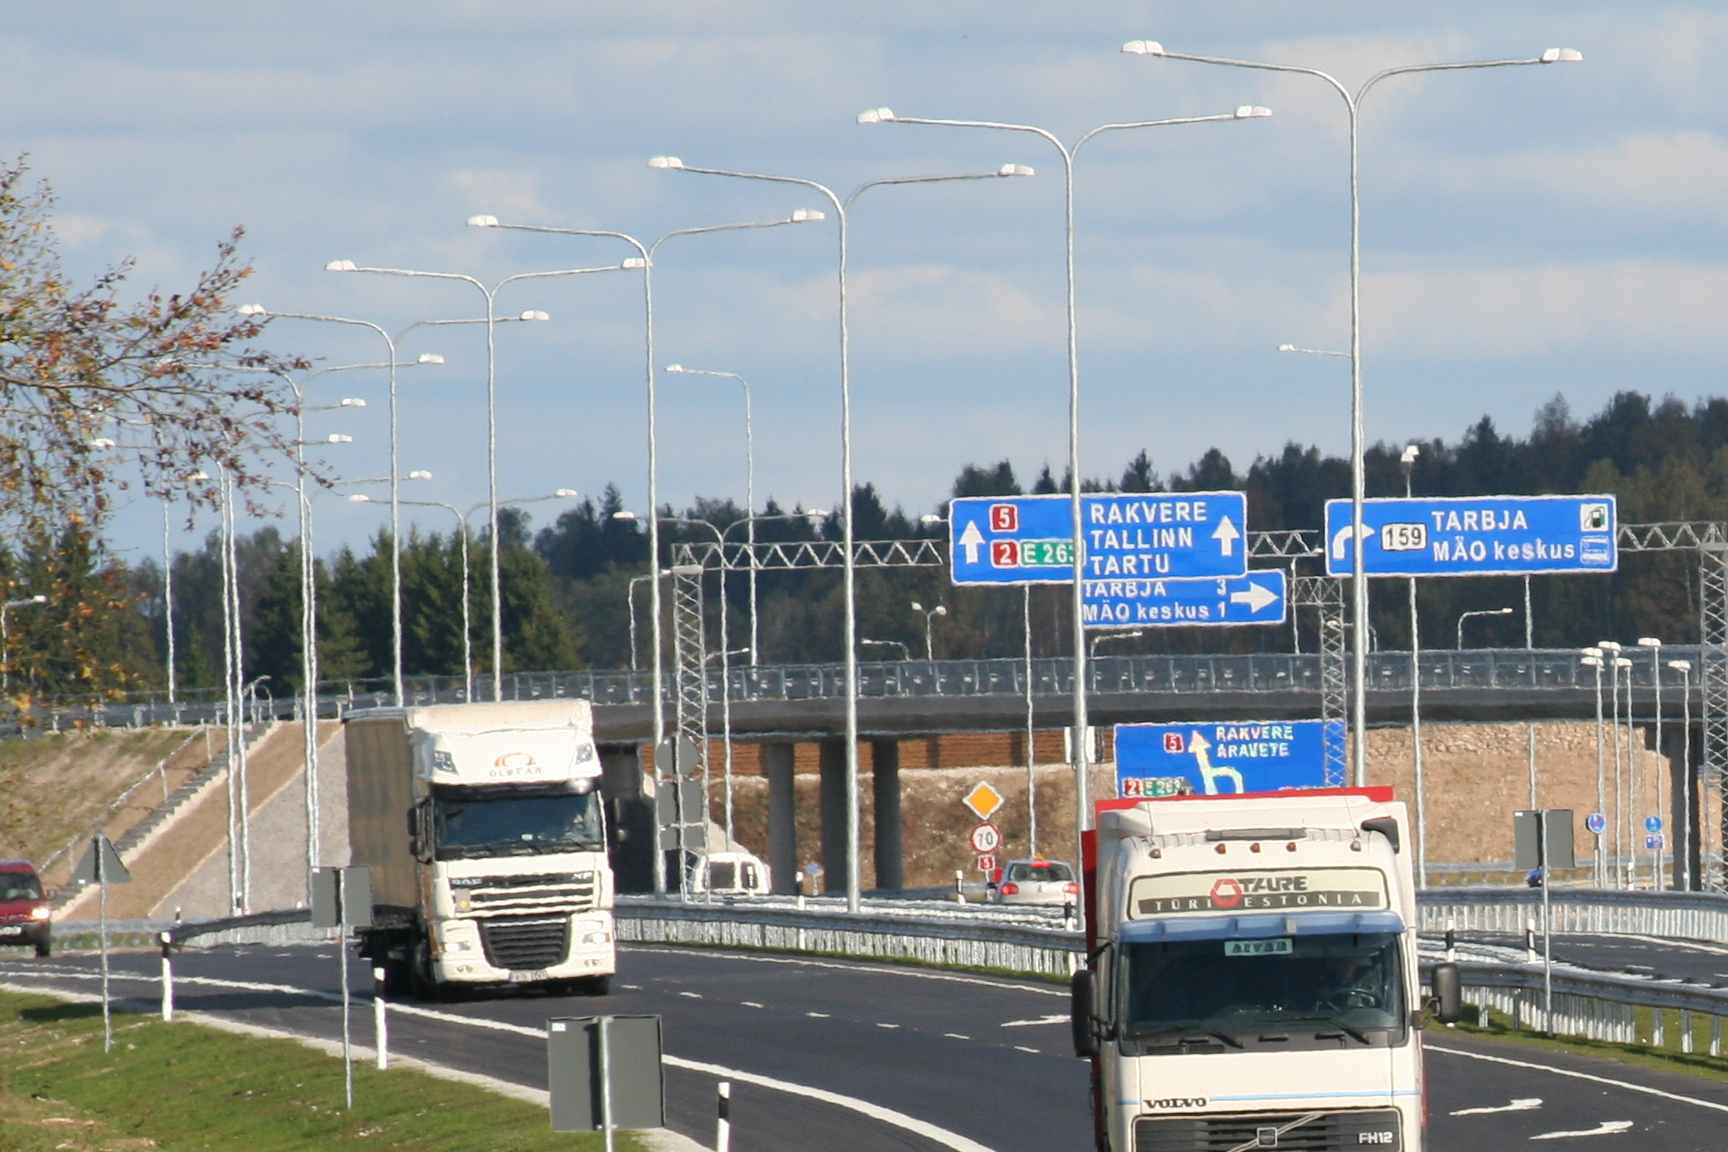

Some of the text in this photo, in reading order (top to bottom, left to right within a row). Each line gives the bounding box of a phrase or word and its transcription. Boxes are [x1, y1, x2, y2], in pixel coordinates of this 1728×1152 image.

[998, 508, 1010, 528] 5
[1090, 502, 1208, 524] RAKVERE
[1432, 510, 1528, 531] TARBJA
[1090, 528, 1193, 550] TALLINN
[1385, 527, 1422, 547] 159
[999, 543, 1012, 563] 2
[1023, 543, 1037, 564] E
[1432, 537, 1575, 562] MÄO keskus
[1090, 554, 1169, 576] TARTU
[1085, 578, 1226, 598] TARBJA 3
[1083, 600, 1226, 621] MÄO keskus 1
[1168, 736, 1177, 750] 5
[1216, 725, 1294, 741] RAKVERE
[1217, 742, 1289, 758] ARAVETE
[1127, 780, 1137, 795] 2
[977, 831, 994, 847] 70
[1244, 893, 1362, 908] ESTONIA
[1143, 1097, 1207, 1108] VOLVO
[1359, 1131, 1392, 1145] FH12
